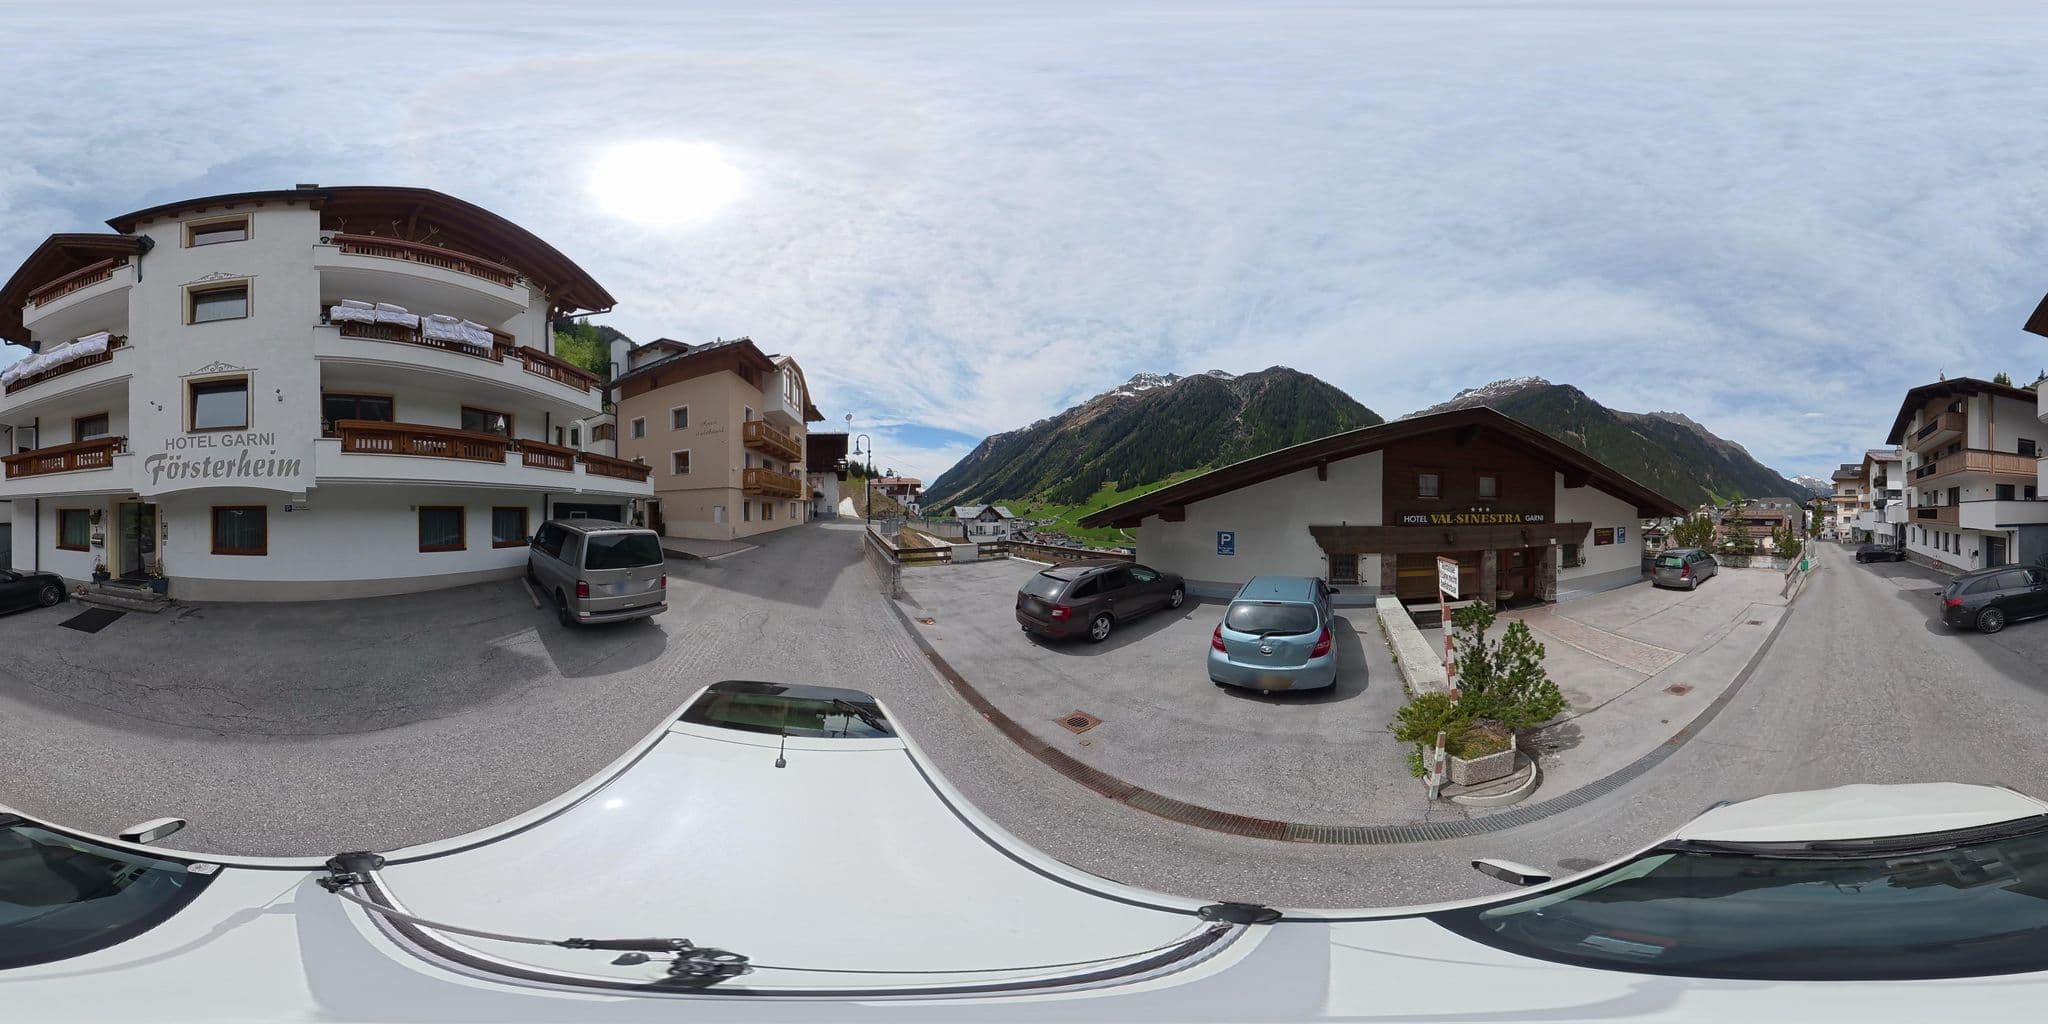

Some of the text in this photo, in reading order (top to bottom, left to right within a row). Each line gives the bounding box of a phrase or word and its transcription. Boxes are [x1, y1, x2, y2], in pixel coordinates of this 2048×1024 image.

[165, 433, 275, 450] HOTEL GARNI
[144, 448, 301, 486] Försterheim
[1403, 515, 1428, 523] HOTEL
[1430, 514, 1522, 524] VAL-SINESTRA
[1618, 528, 1625, 537] P
[1221, 534, 1231, 544] P
